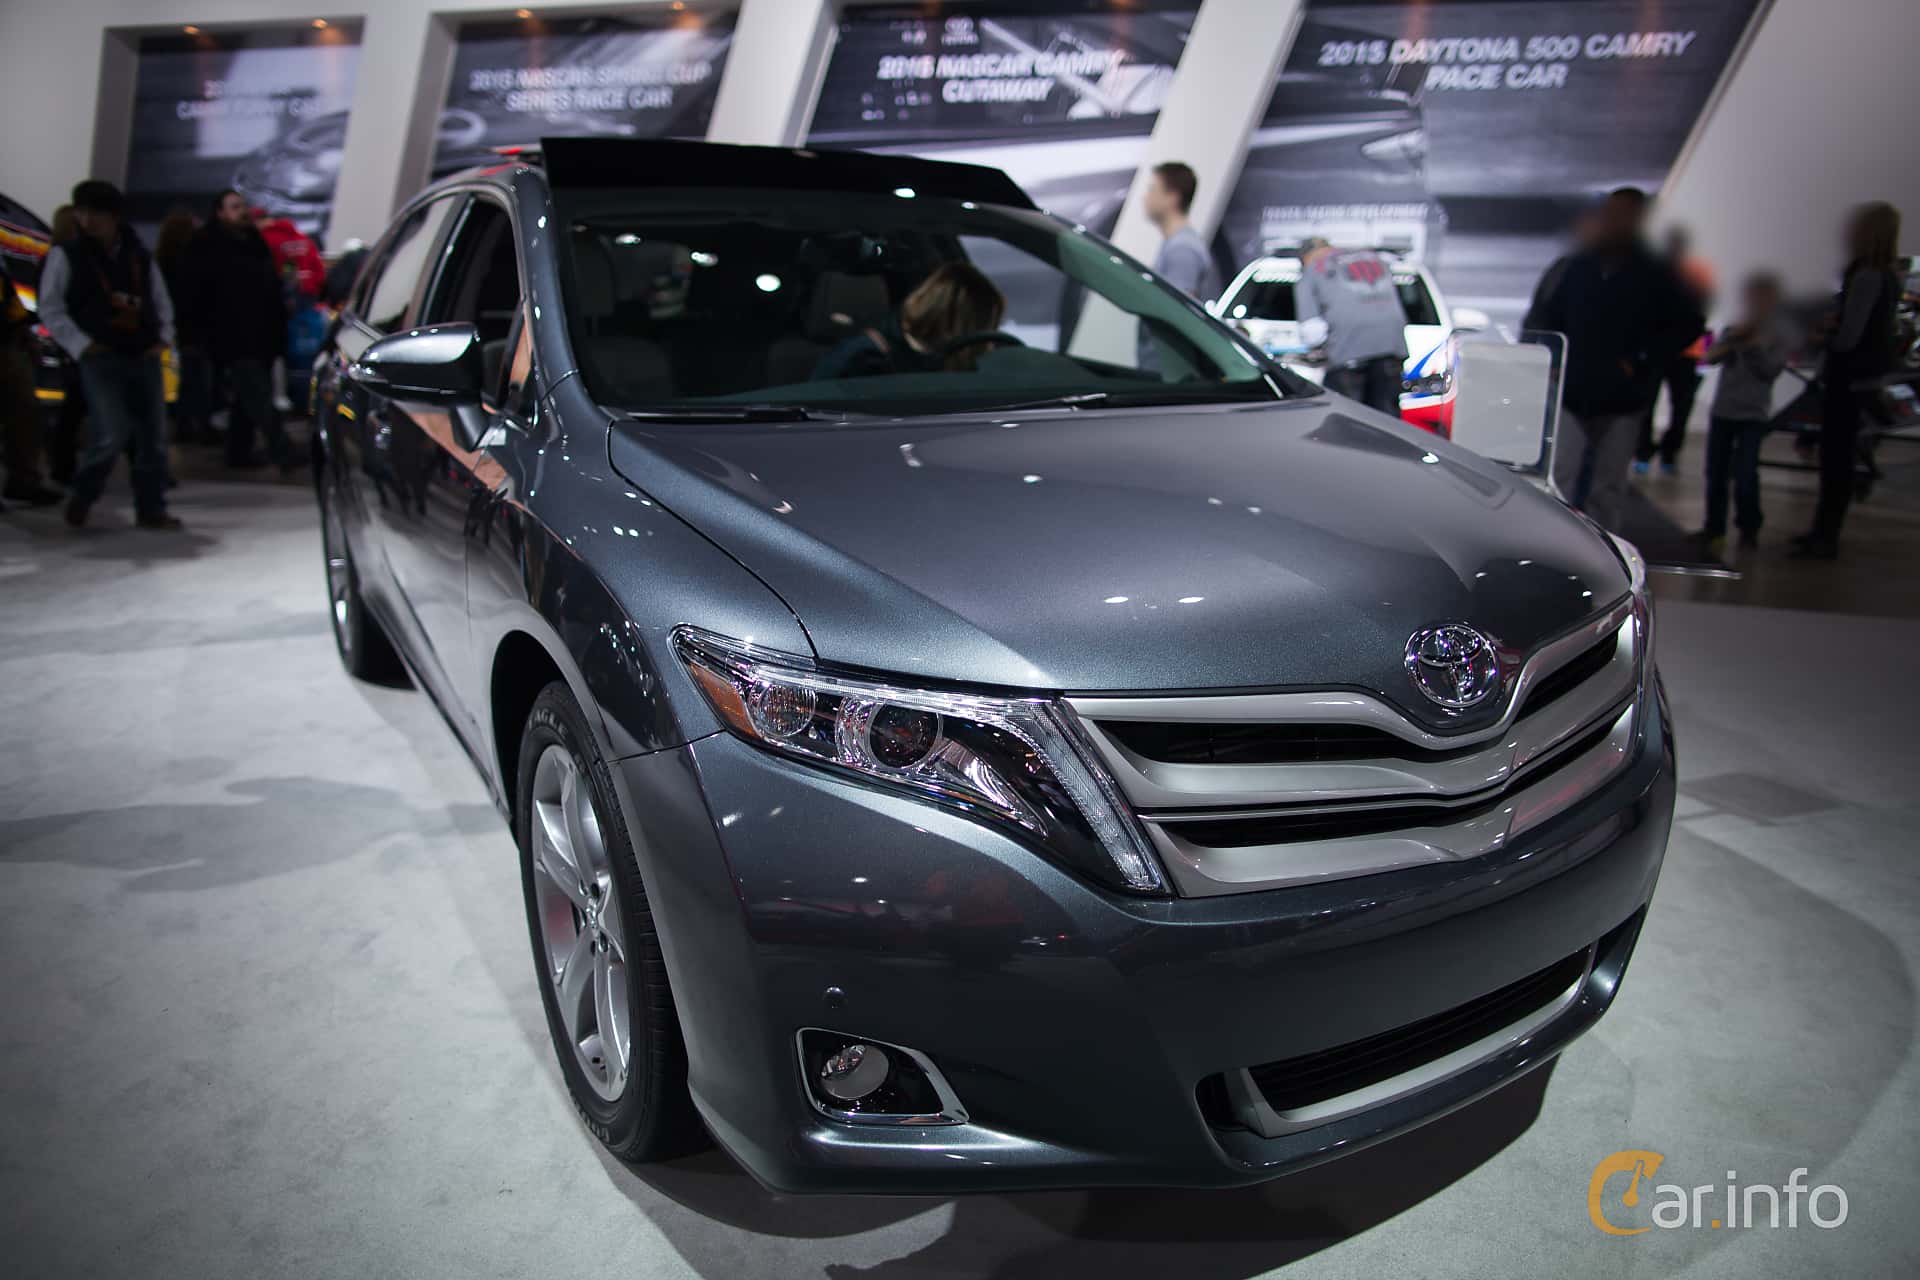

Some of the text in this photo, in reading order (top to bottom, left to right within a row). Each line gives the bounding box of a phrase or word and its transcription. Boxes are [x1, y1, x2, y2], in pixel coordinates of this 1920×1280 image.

[1388, 37, 1520, 64] DAYTONA
[1525, 35, 1580, 62] 500
[1585, 31, 1697, 59] CAMRY
[936, 53, 1031, 79] NASCAR
[1424, 62, 1568, 91] PACE CAR
[506, 89, 573, 113] SERIES
[628, 85, 673, 109] CAR
[942, 78, 1055, 103] CUTAWAY
